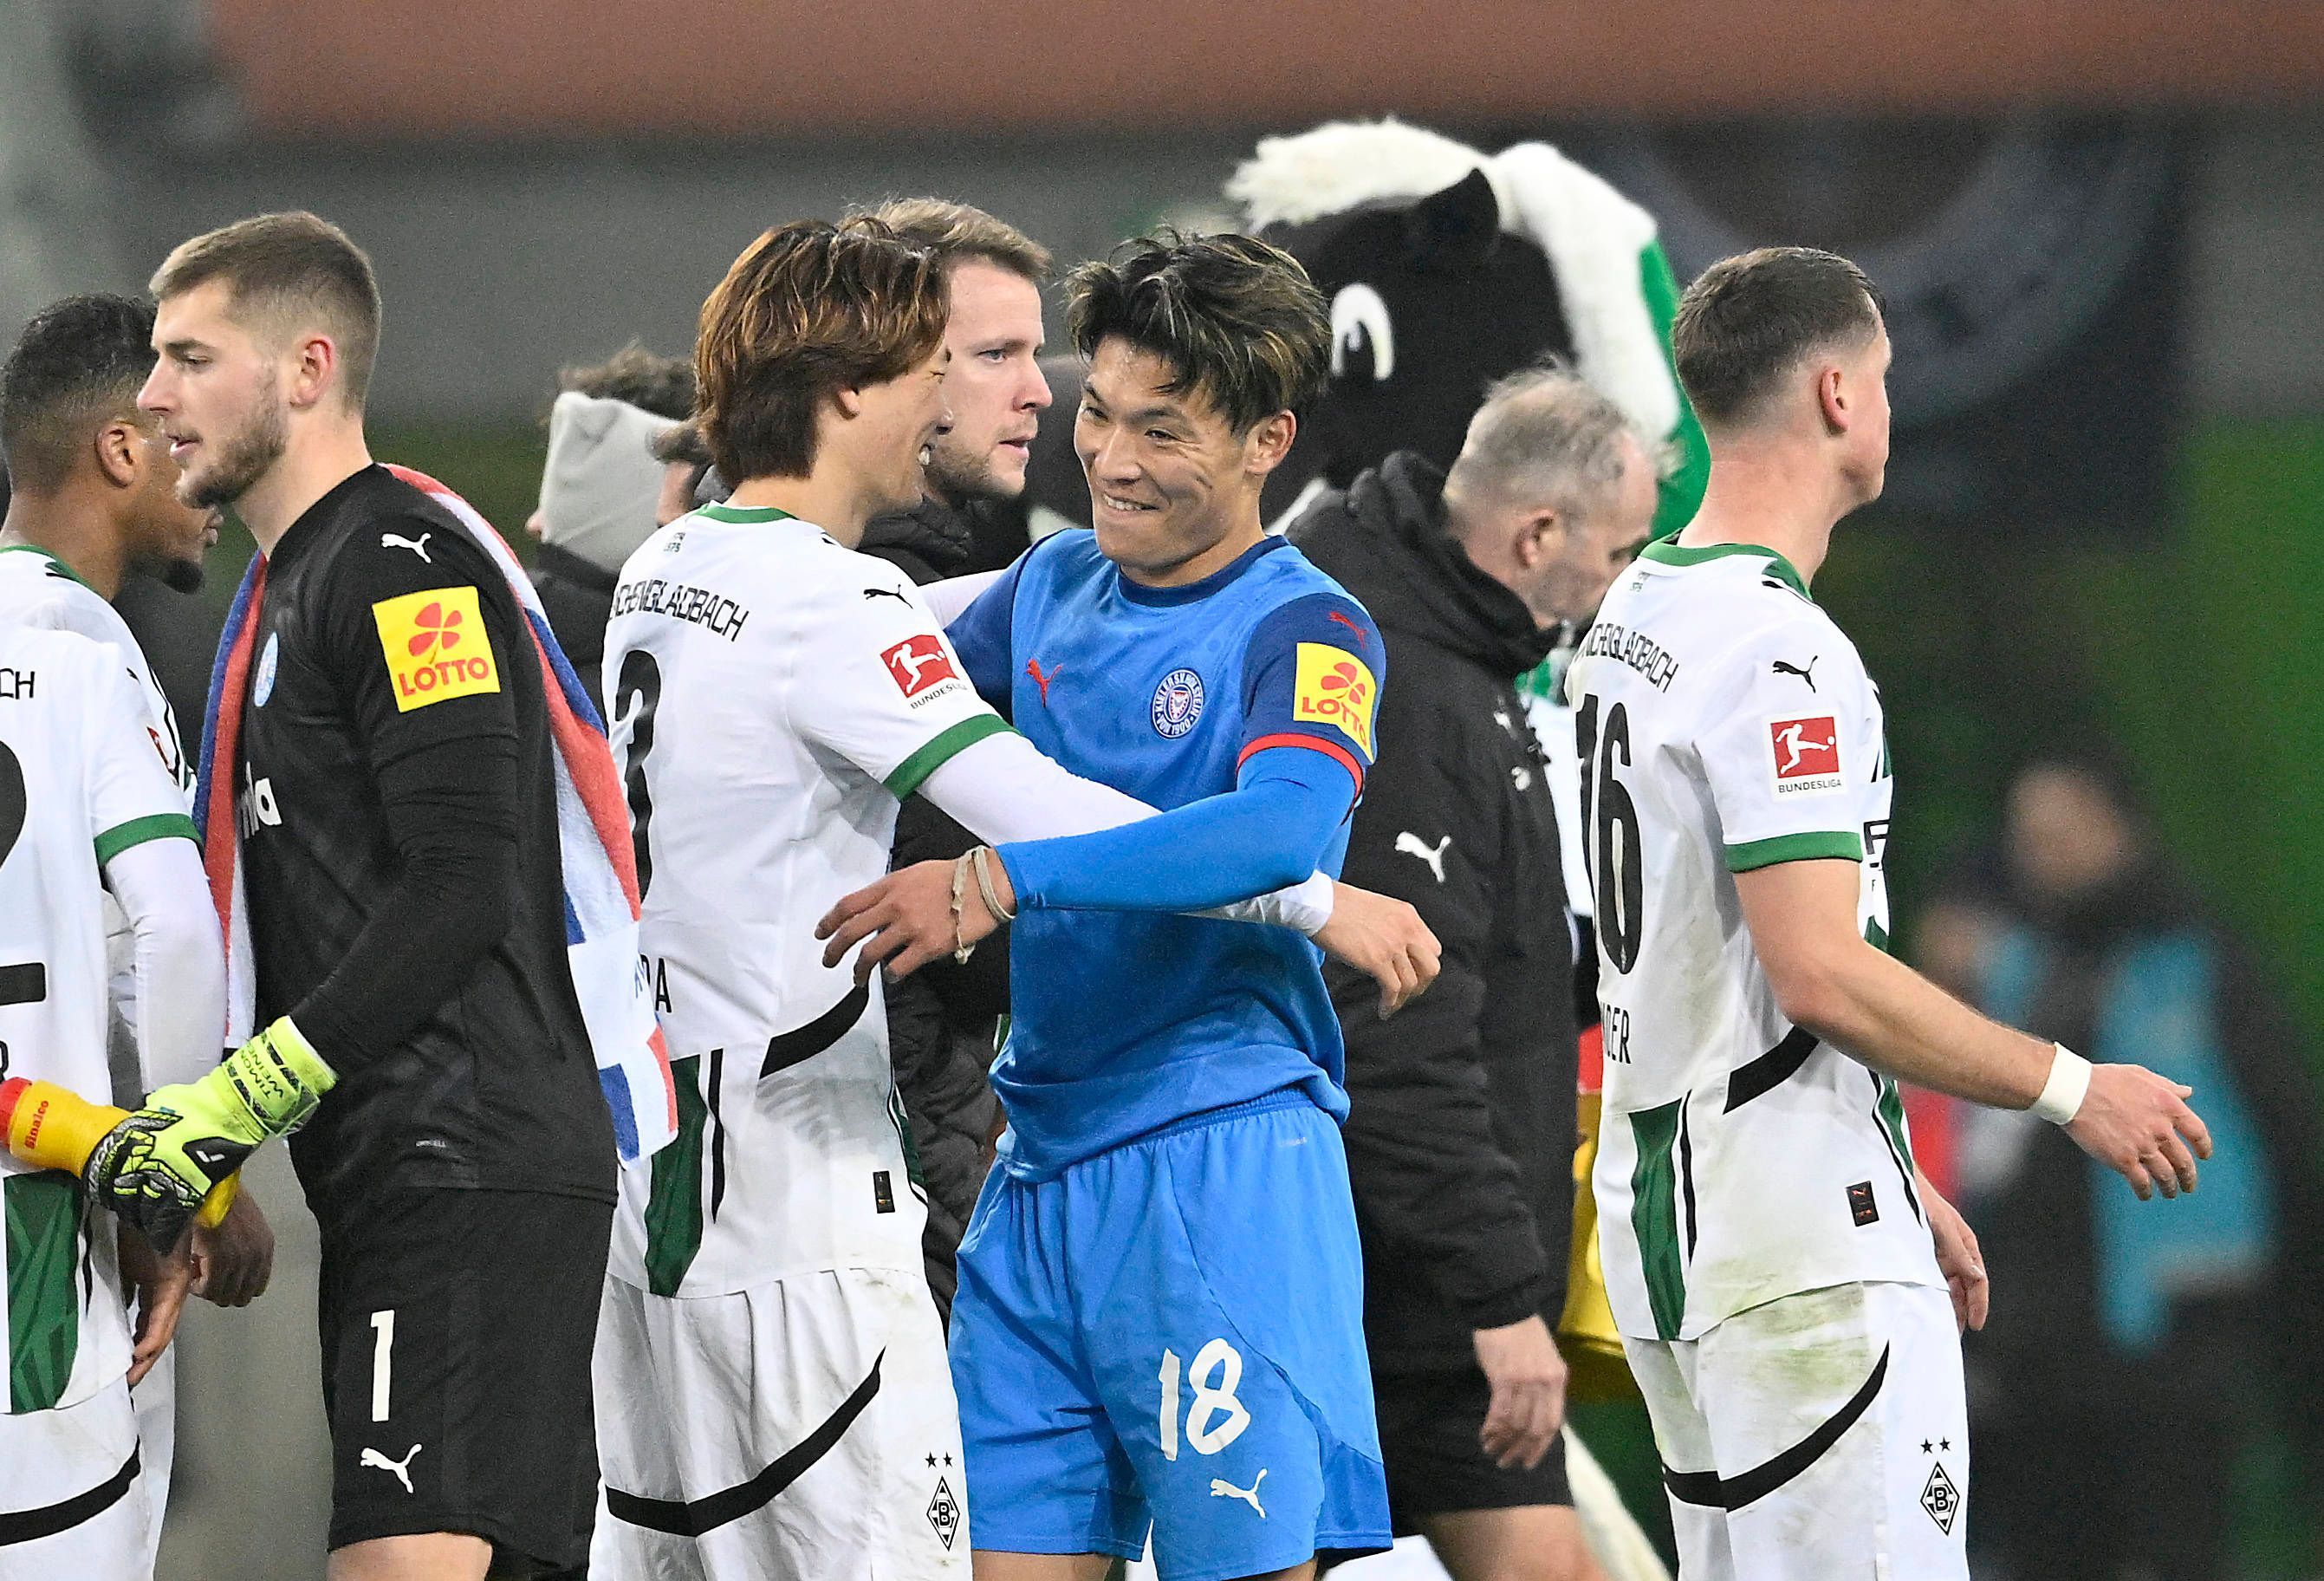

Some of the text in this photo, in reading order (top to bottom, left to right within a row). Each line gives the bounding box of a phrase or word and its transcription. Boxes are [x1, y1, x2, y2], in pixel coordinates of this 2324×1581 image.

[399, 657, 489, 697] LOTTO
[1302, 697, 1367, 746] LOTTO
[1778, 778, 1842, 794] BUNDESLIGA
[370, 1309, 395, 1422] 1
[1158, 1337, 1251, 1461] 18
